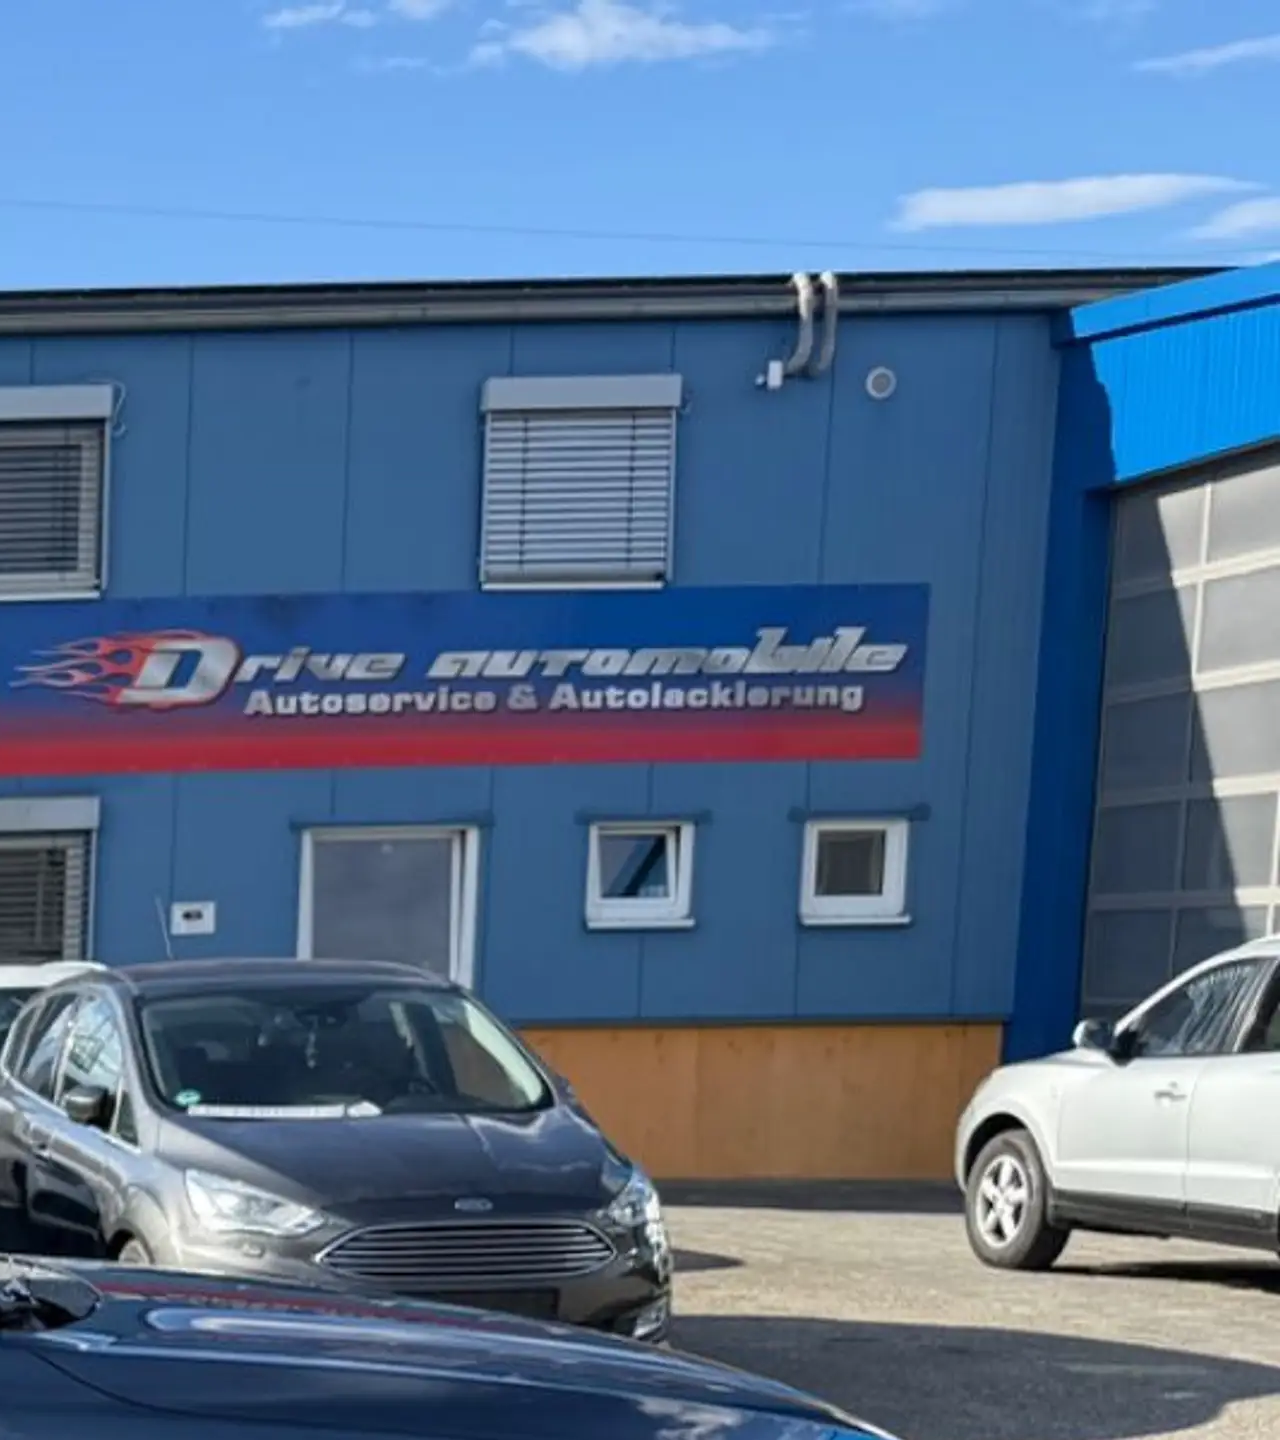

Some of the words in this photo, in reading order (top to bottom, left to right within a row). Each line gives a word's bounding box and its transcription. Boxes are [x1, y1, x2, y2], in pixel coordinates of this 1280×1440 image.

[116, 637, 406, 705] Drive
[426, 625, 908, 681] automobile
[243, 685, 496, 716] Autoservice
[506, 682, 538, 712] &
[548, 680, 864, 713] Autolackierung
